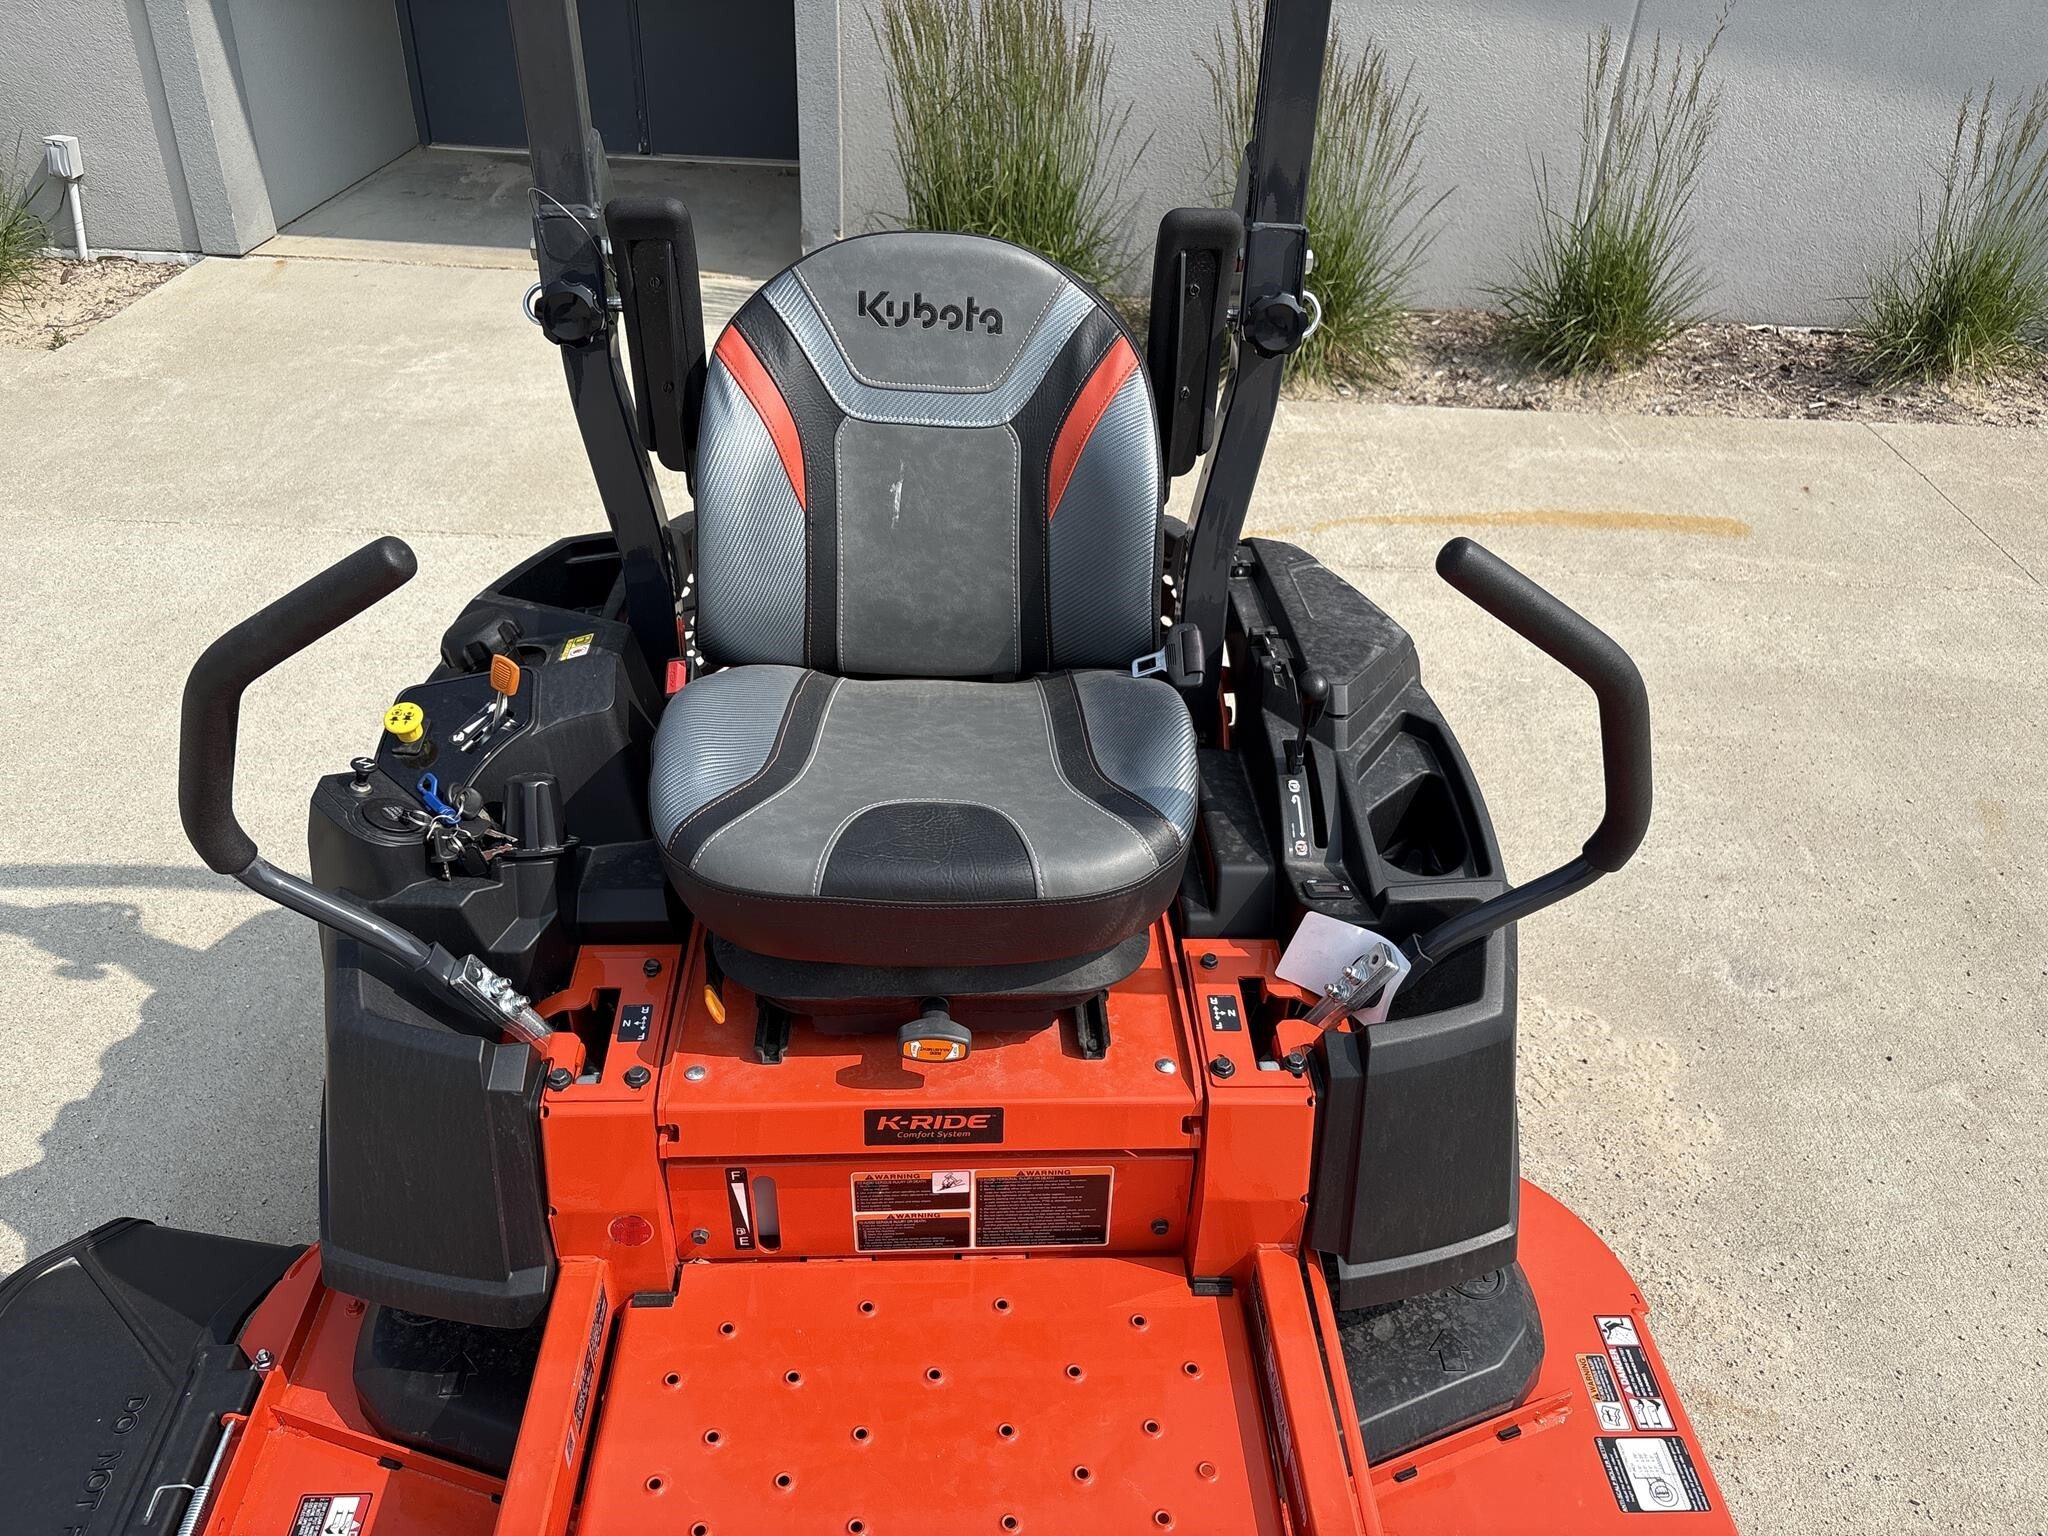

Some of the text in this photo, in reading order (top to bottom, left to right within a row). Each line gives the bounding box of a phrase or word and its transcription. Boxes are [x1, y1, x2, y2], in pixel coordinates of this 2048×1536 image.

[857, 290, 1004, 335] Kubota
[622, 1019, 631, 1027] N
[1227, 1009, 1236, 1017] N
[897, 1130, 971, 1139] Comfort System
[730, 1171, 741, 1181] F
[739, 1236, 749, 1246] E
[1579, 1358, 1596, 1392] WARNING
[1607, 1349, 1628, 1386] DANGER
[111, 1393, 151, 1436] DO
[76, 1450, 125, 1511] NOT
